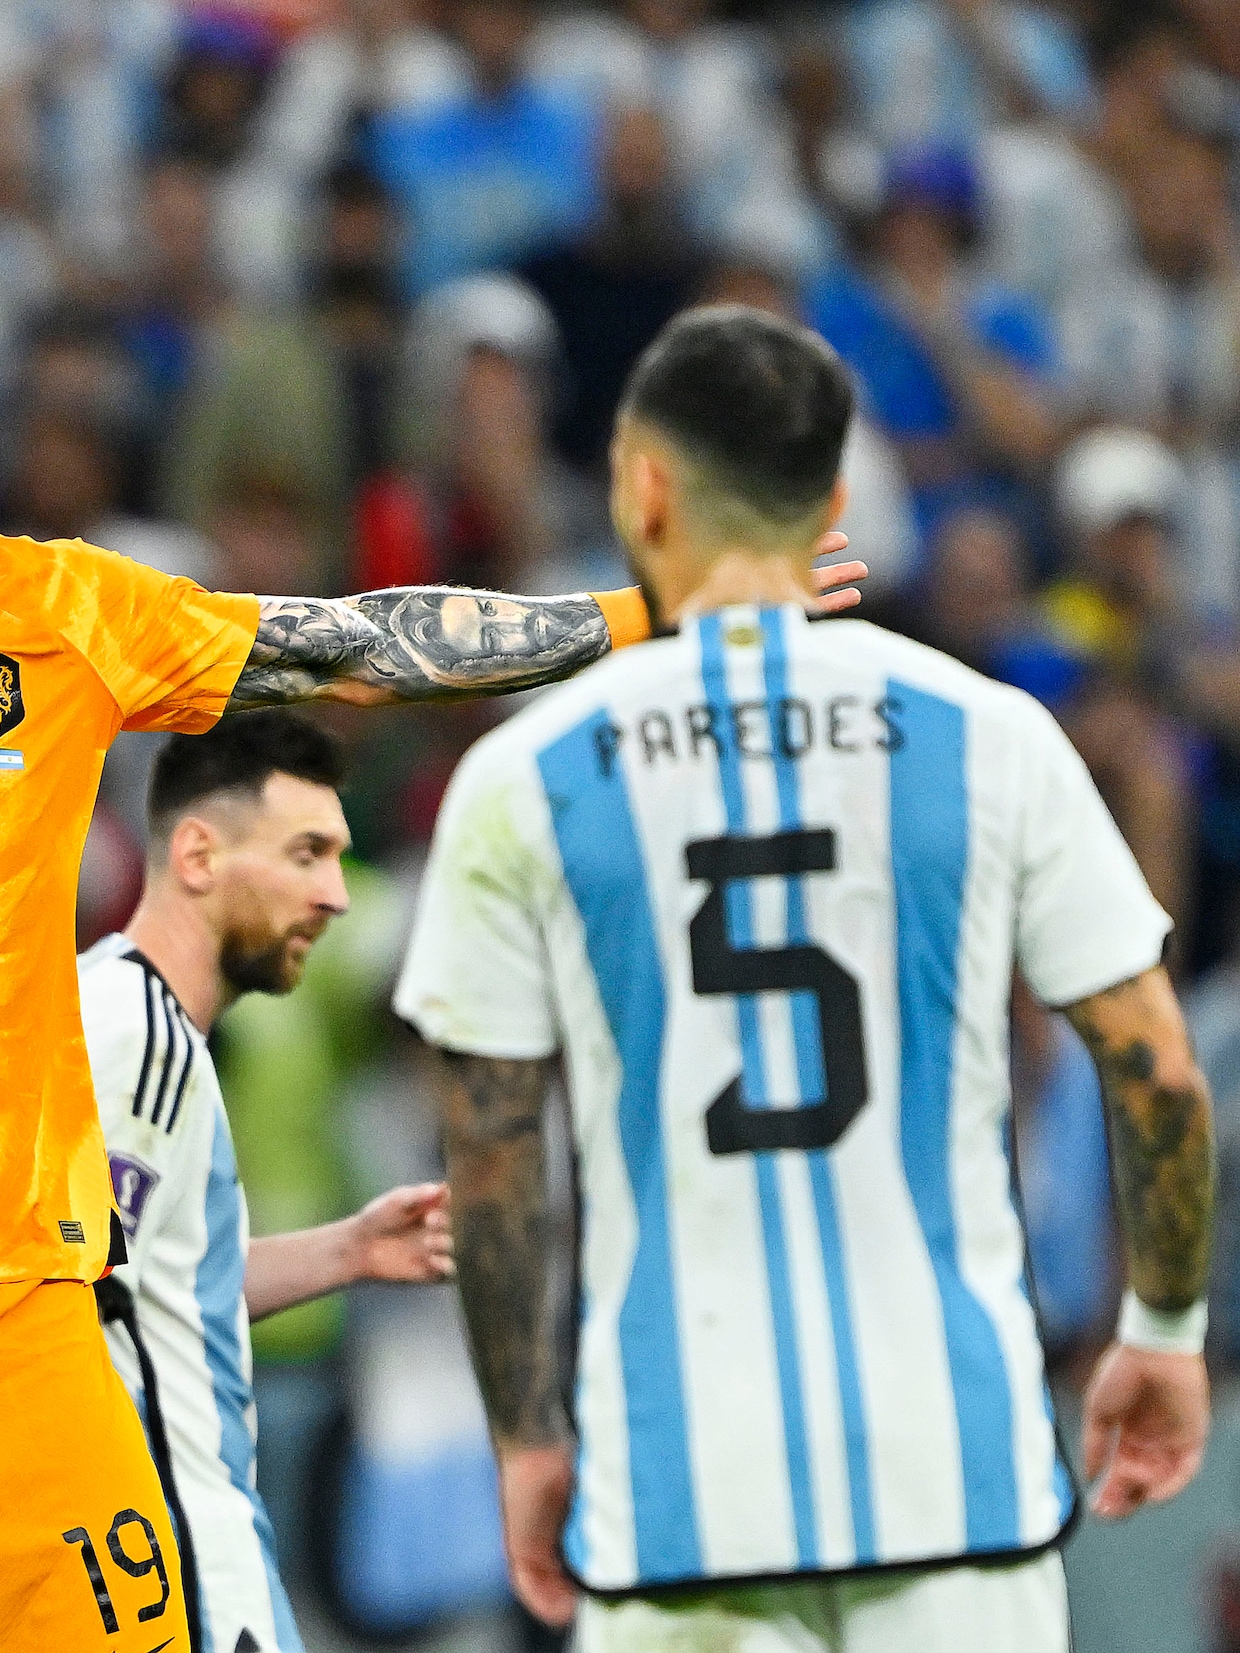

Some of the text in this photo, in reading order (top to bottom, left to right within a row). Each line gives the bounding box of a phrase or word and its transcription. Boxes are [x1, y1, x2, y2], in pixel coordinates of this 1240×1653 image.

[592, 695, 907, 780] PAREDES
[685, 828, 871, 1155] 5
[61, 1508, 170, 1634] 19
